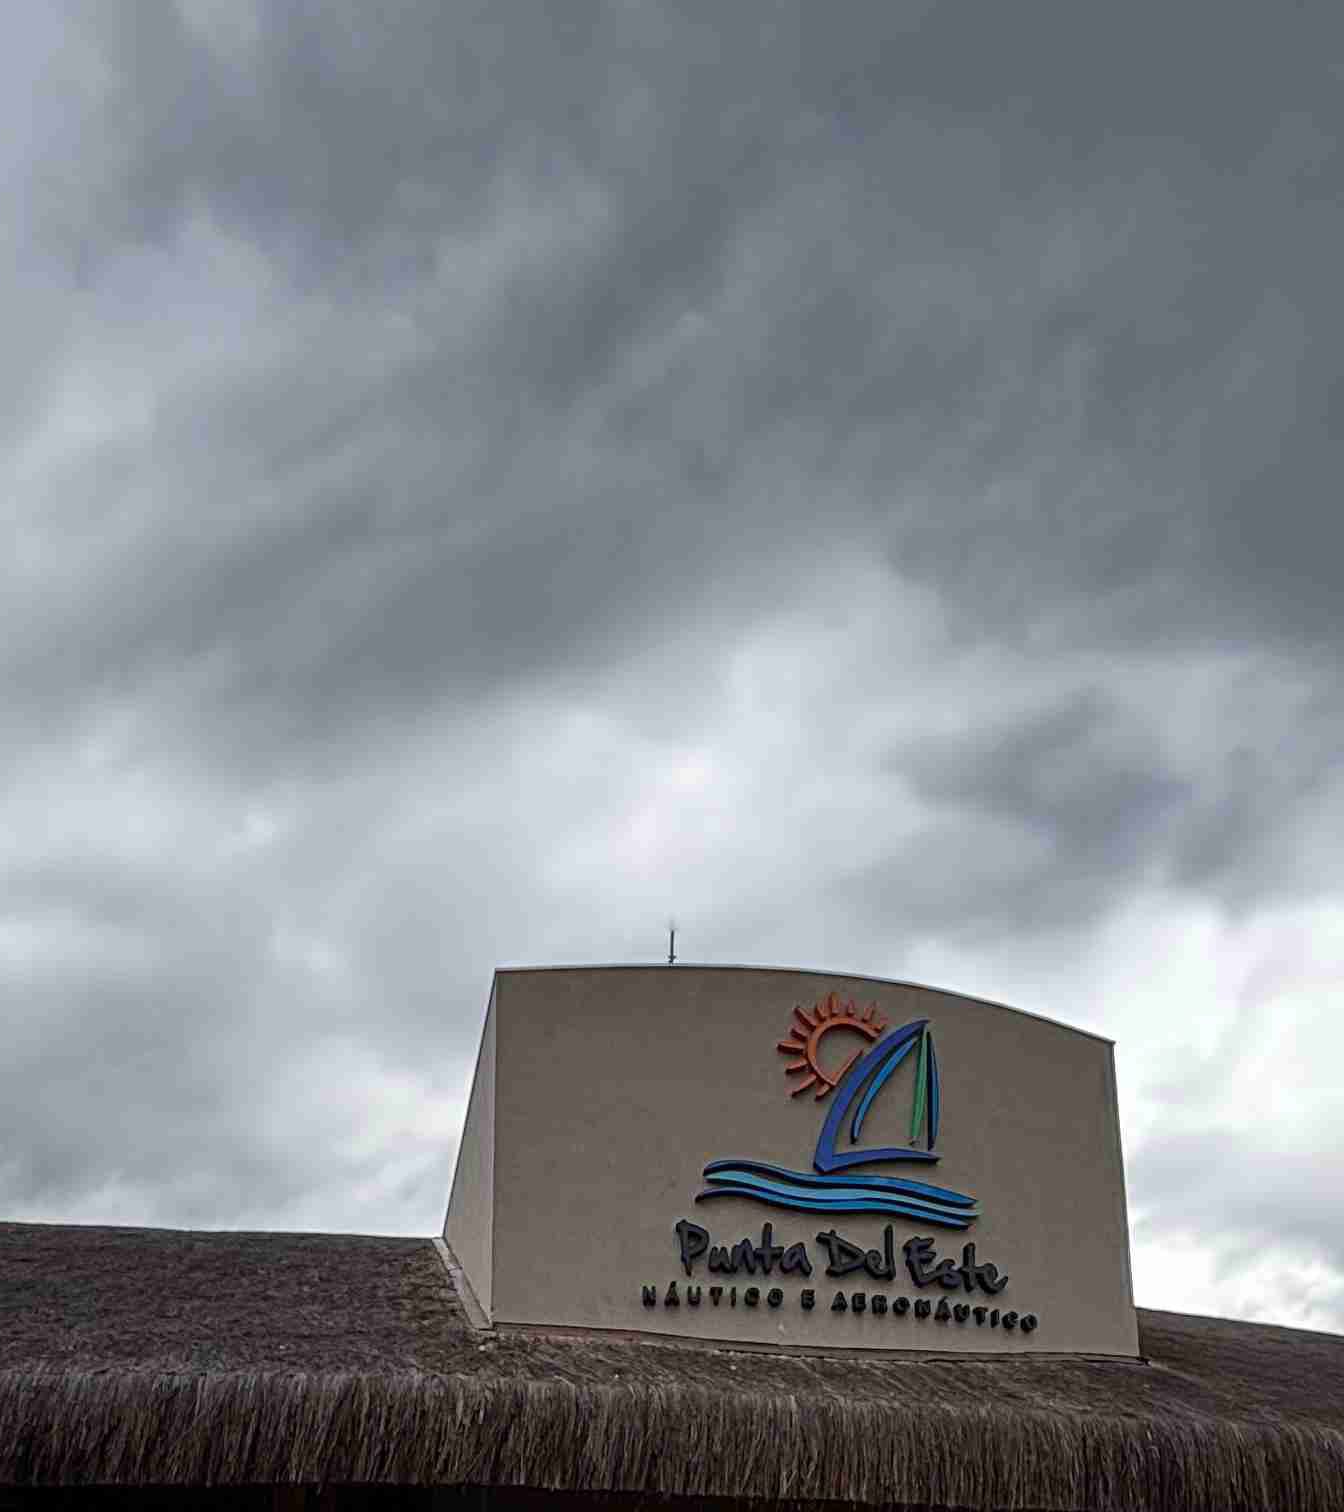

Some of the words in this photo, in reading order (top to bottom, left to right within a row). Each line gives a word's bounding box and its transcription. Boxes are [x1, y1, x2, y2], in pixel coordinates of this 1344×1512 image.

[675, 1219, 813, 1277] Punta
[816, 1224, 896, 1281] Del
[903, 1236, 1009, 1295] Este
[642, 1281, 784, 1309] NÁUTICO
[800, 1288, 815, 1311] E
[831, 1291, 1038, 1332] AERONÁUTICO
